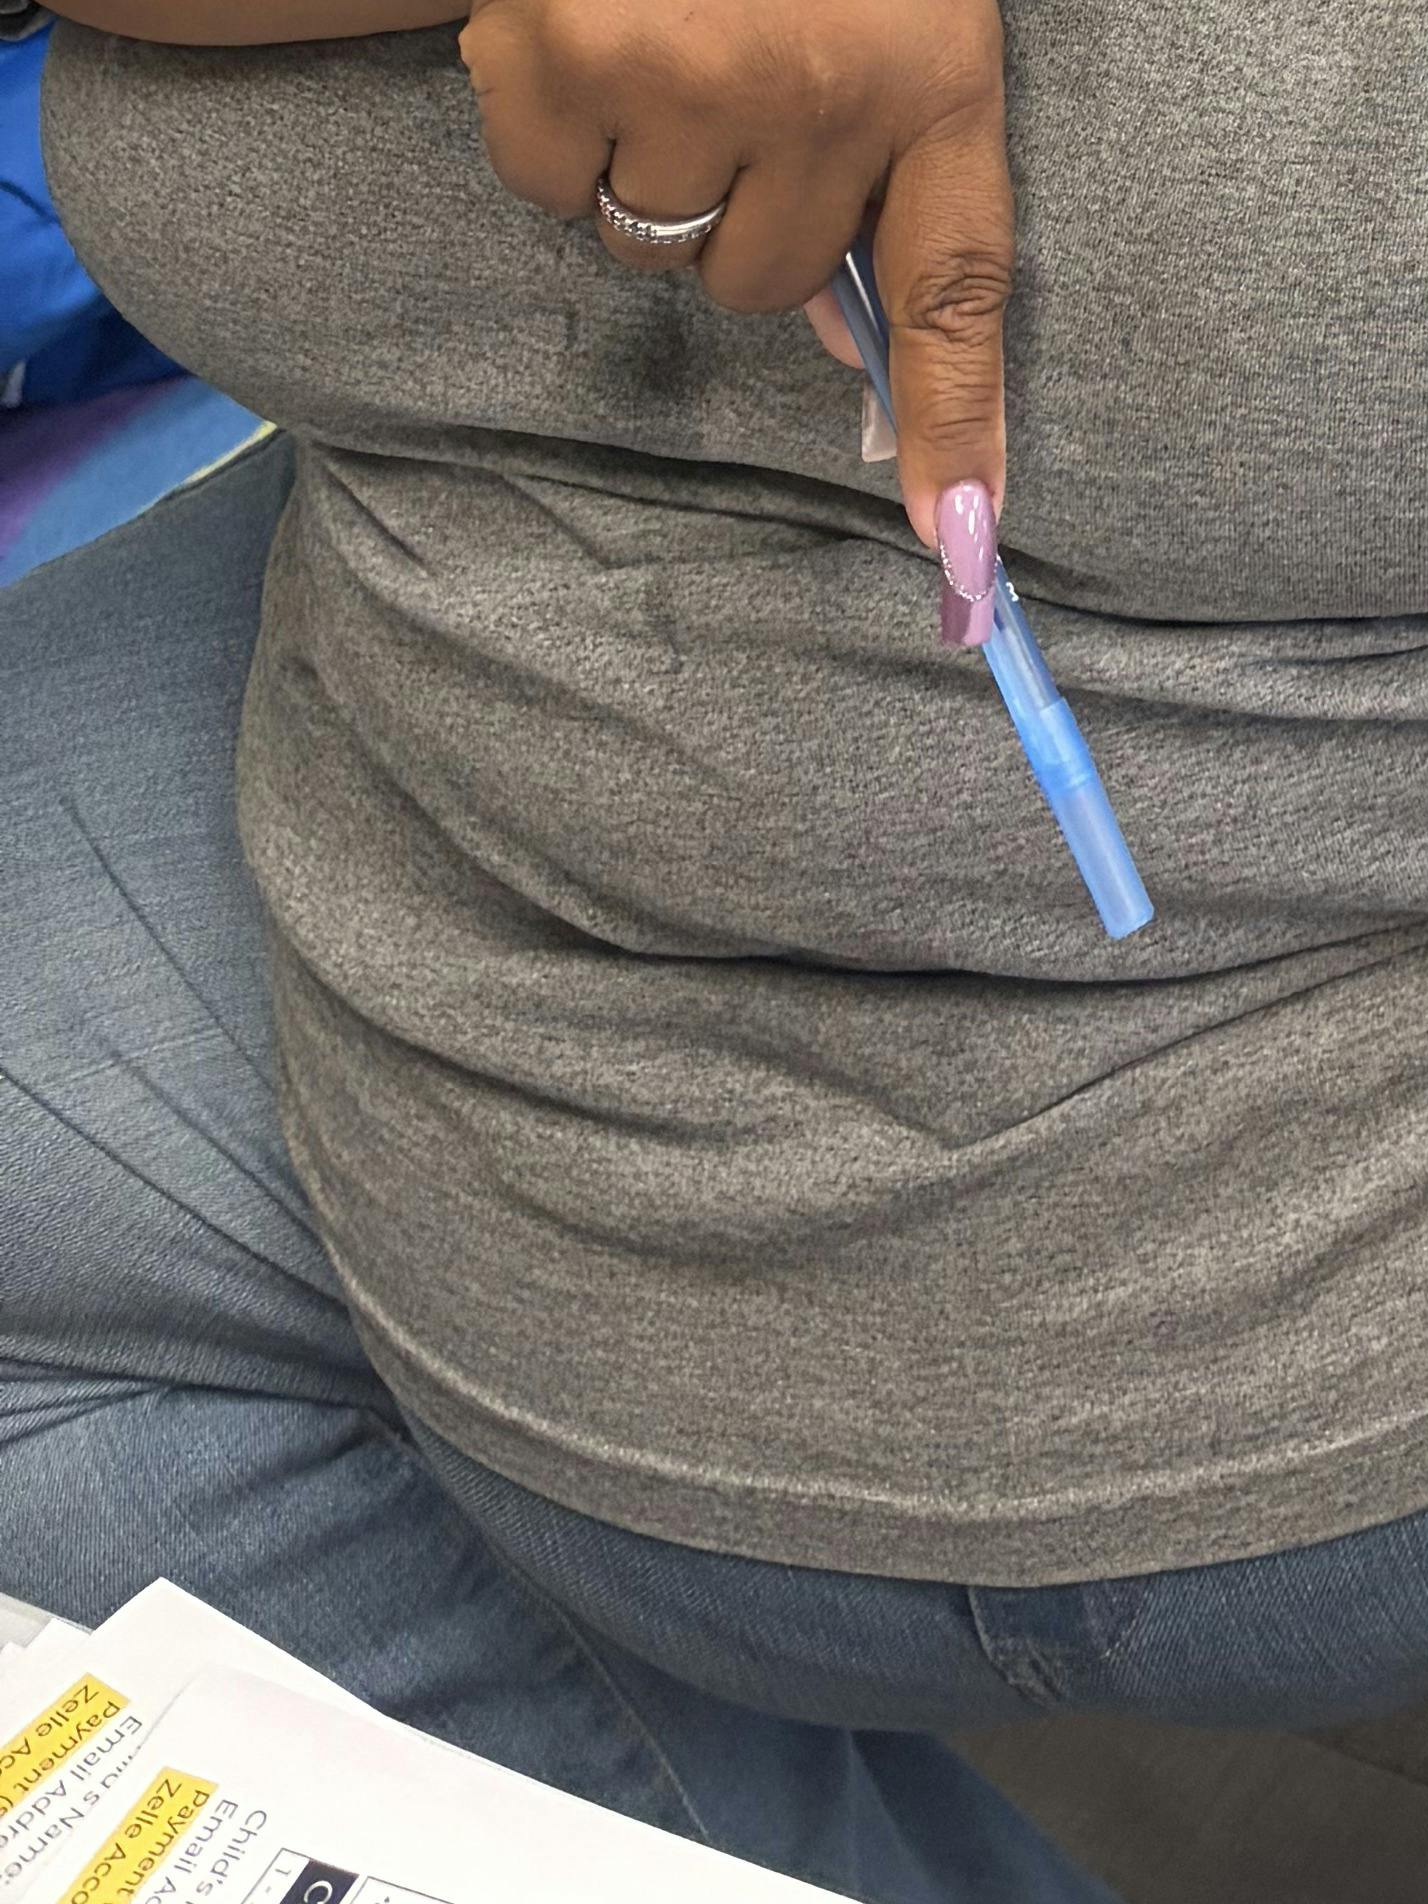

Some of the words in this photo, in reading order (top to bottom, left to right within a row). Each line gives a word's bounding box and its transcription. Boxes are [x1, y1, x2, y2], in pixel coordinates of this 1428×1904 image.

[12, 1700, 122, 1793] Payment
[35, 1684, 100, 1738] Zelle
[70, 1715, 143, 1782] Email
[116, 1789, 211, 1898] Payment
[124, 1778, 183, 1840] Zelle
[174, 1799, 239, 1875] Email
[195, 1809, 268, 1898] Child's
